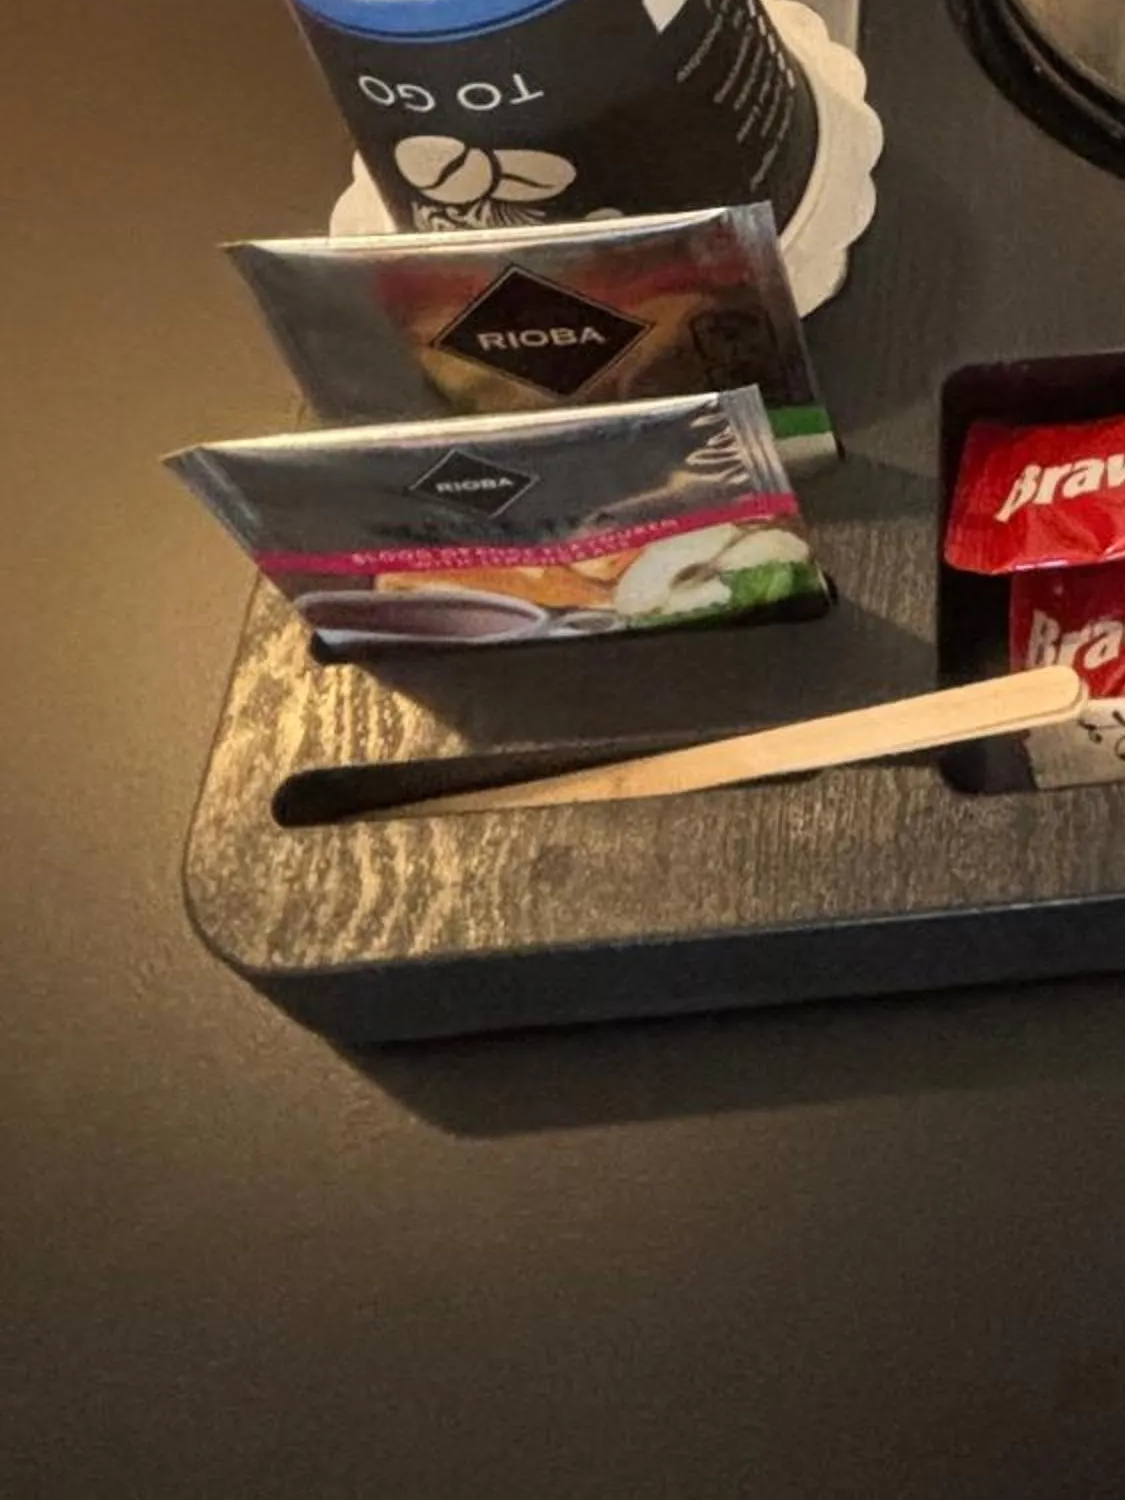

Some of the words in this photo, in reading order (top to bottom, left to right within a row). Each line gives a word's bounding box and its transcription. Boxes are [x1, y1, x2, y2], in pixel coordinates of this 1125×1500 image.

[358, 74, 436, 112] GO
[456, 73, 545, 111] TO
[476, 324, 606, 353] RIOBA
[435, 473, 515, 495] RIOBA
